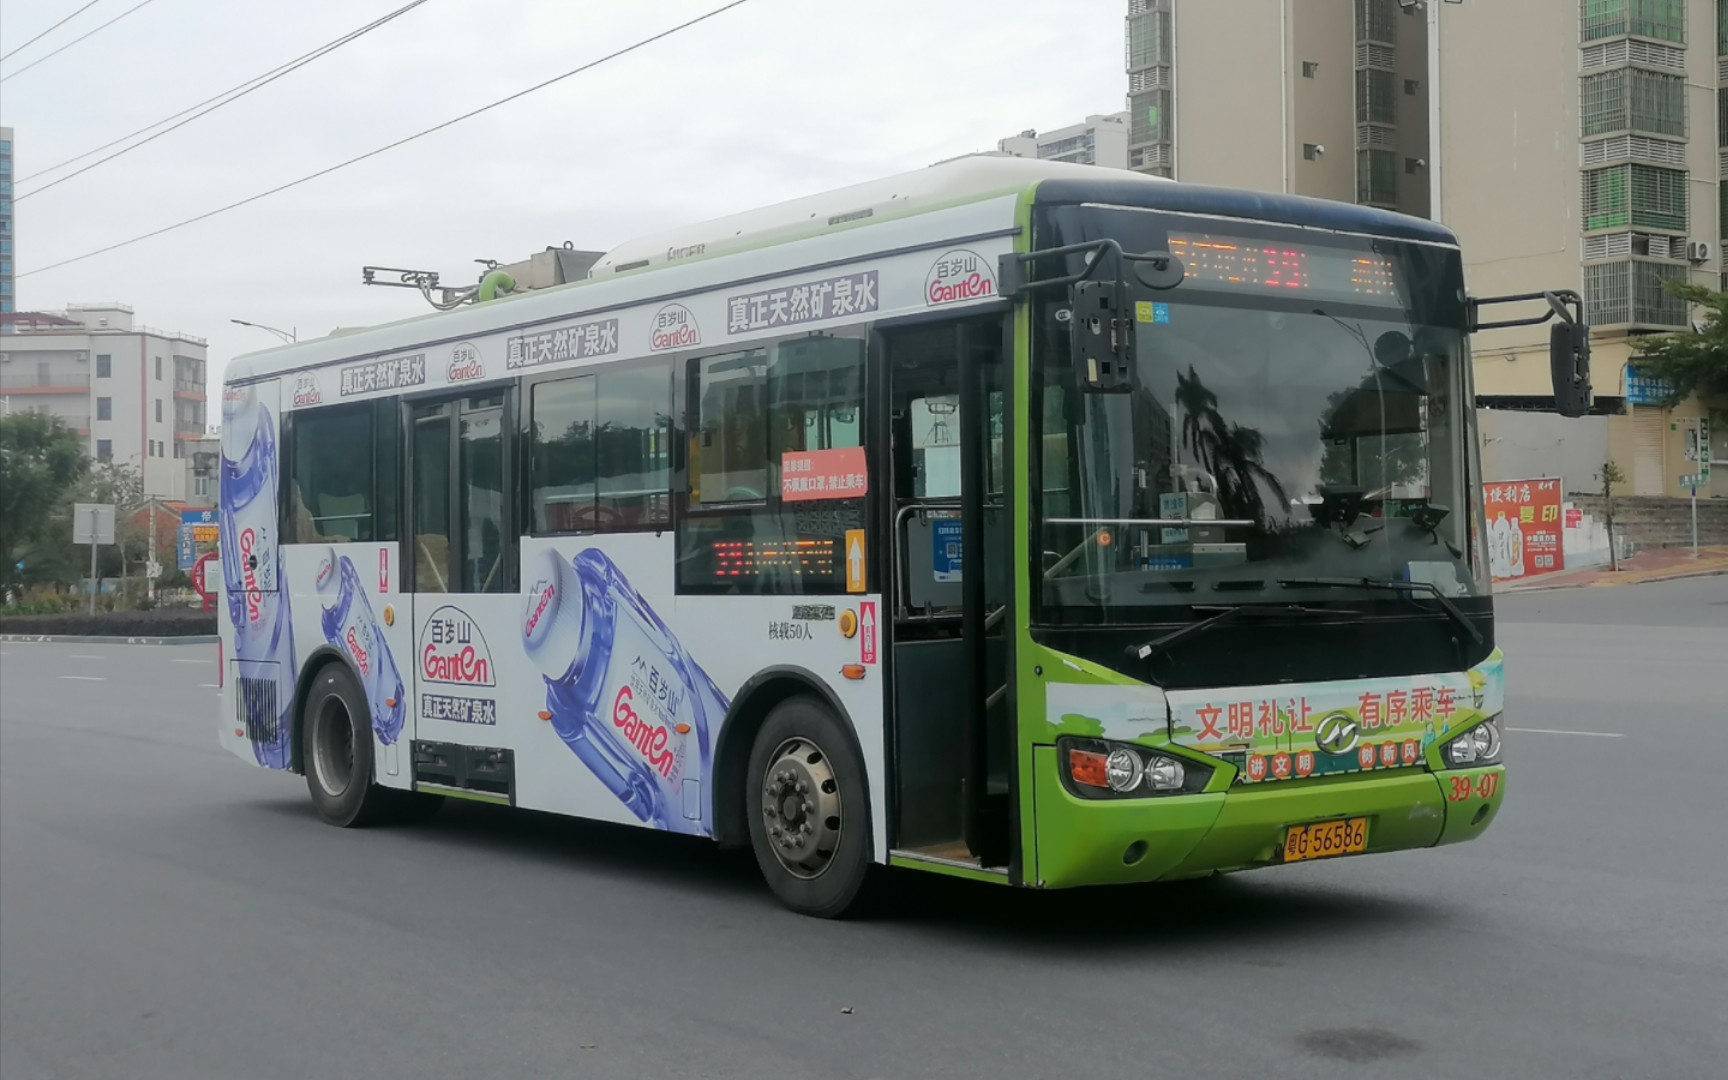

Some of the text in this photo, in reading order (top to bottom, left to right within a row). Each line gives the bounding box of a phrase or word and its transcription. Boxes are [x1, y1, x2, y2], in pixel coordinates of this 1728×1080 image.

[937, 256, 977, 279] 百岁山
[929, 273, 993, 303] Ganten
[729, 274, 876, 332] 真正天然矿泉水
[658, 310, 688, 329] 百岁山
[508, 321, 617, 368] 真正天然矿泉水
[652, 326, 697, 349] Ganten
[341, 357, 425, 393] 真正天然矿泉水
[448, 359, 483, 382] Ganten
[431, 619, 471, 645] 百岁山
[768, 621, 813, 641] 核载50人
[424, 643, 488, 683] Ganten
[422, 694, 496, 725] 真正天然矿泉水
[1195, 686, 1457, 741] 文明礼让 有序乘车
[1249, 754, 1313, 777] 讲文明
